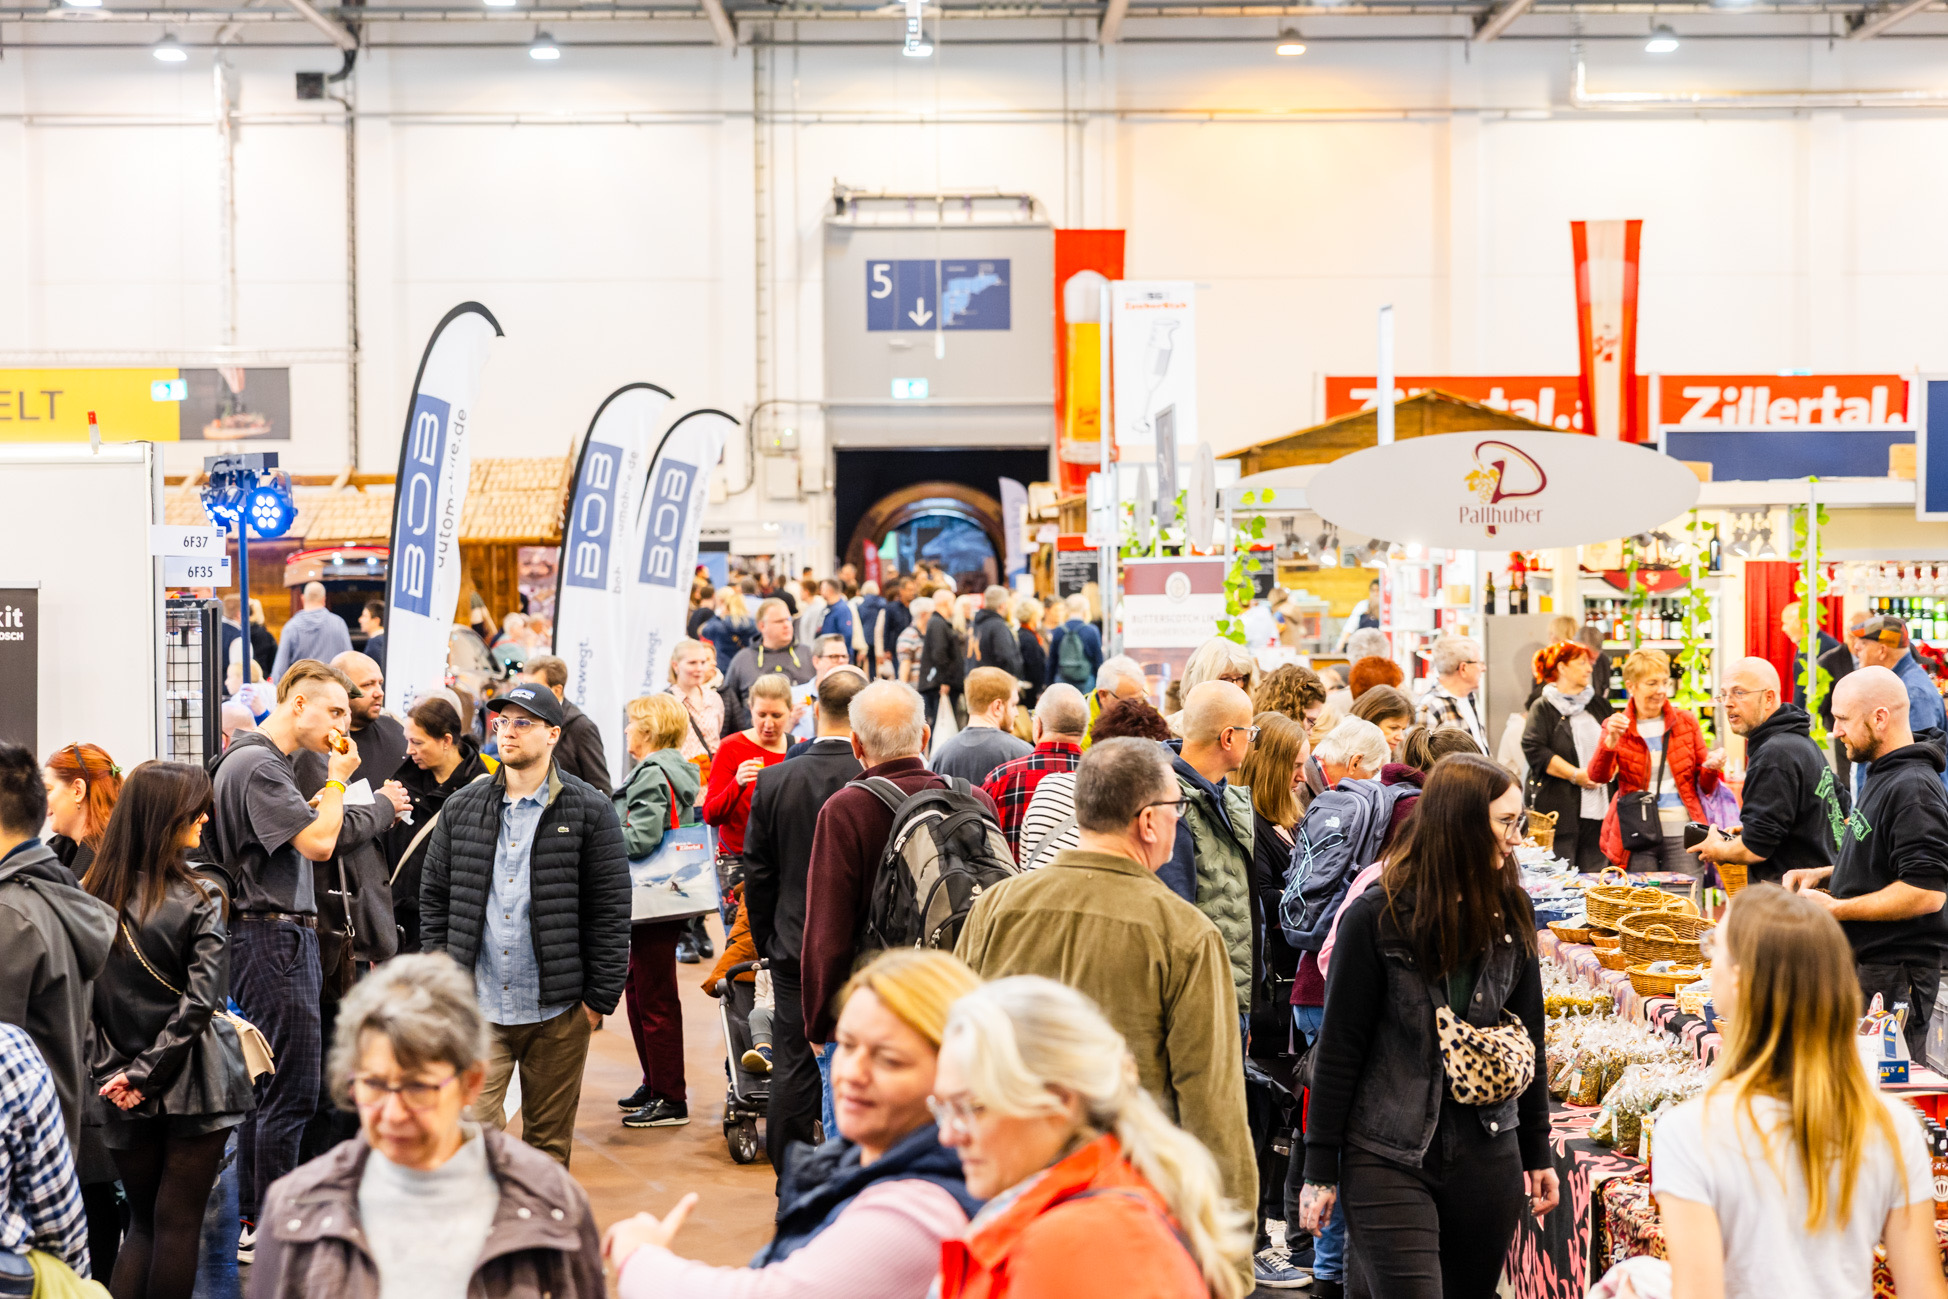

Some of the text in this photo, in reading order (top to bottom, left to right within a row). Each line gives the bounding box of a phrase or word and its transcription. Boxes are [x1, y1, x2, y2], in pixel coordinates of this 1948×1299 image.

[871, 263, 893, 299] 5
[0, 390, 64, 421] ELT
[1680, 385, 1905, 425] Zillertal.
[402, 411, 440, 598] BOB
[575, 452, 613, 579] BOB
[1460, 506, 1543, 524] Pallhuber
[183, 536, 208, 547] 6F37
[647, 471, 688, 578] BOB
[188, 566, 213, 577] 6F35
